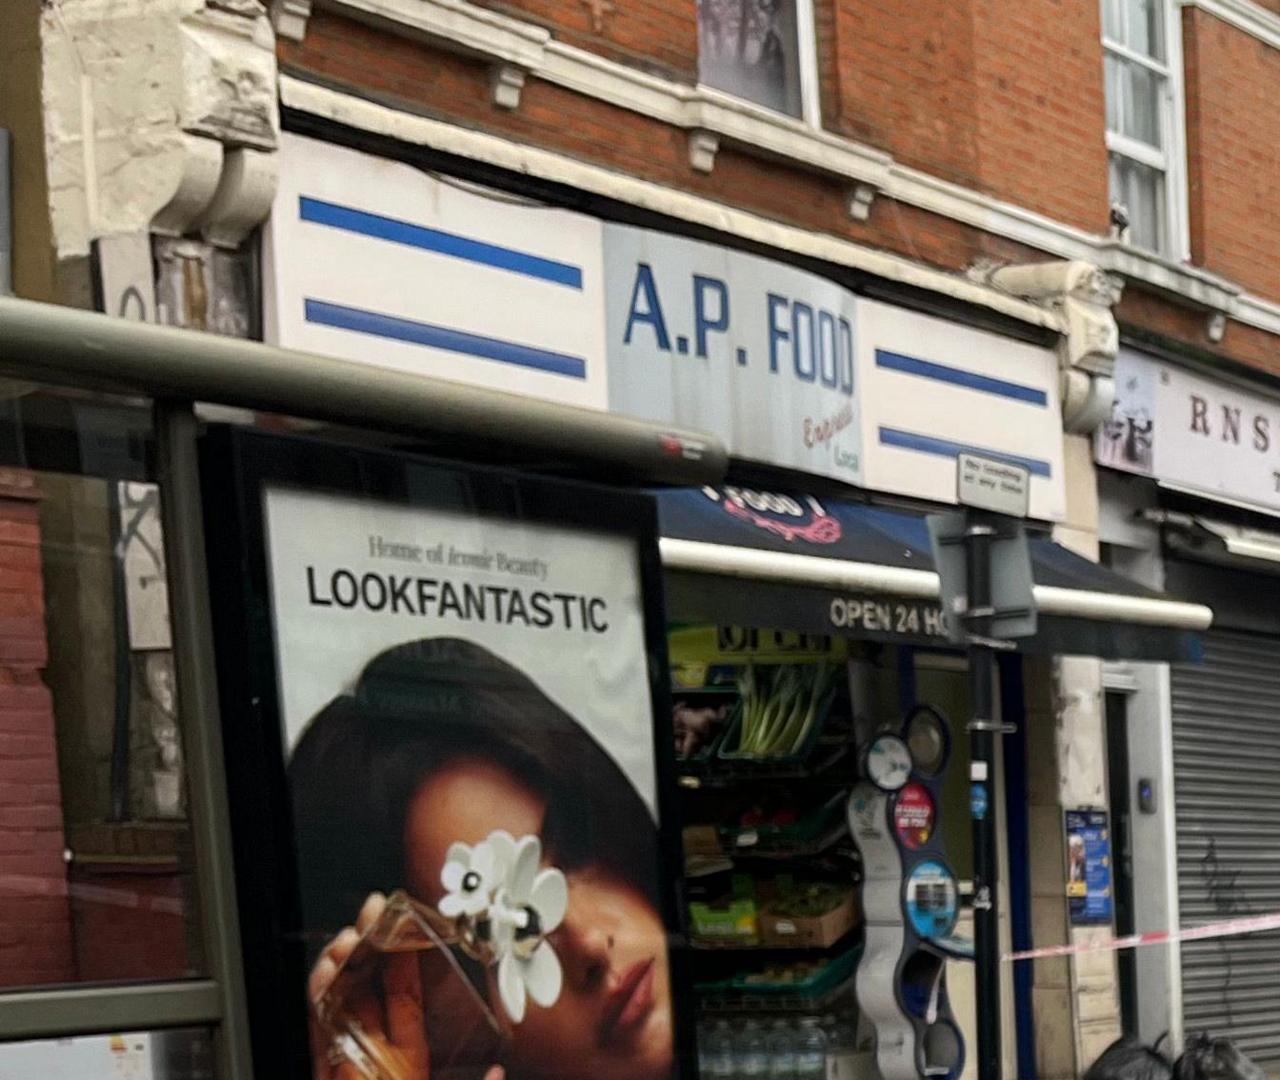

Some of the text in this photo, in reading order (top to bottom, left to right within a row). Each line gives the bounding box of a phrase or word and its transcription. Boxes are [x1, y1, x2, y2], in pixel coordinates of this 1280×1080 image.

[623, 261, 854, 397] A.P. FOOD
[306, 566, 608, 634] LOOKFANTASTIC
[830, 597, 891, 632] OPEN
[895, 604, 920, 633] 24
